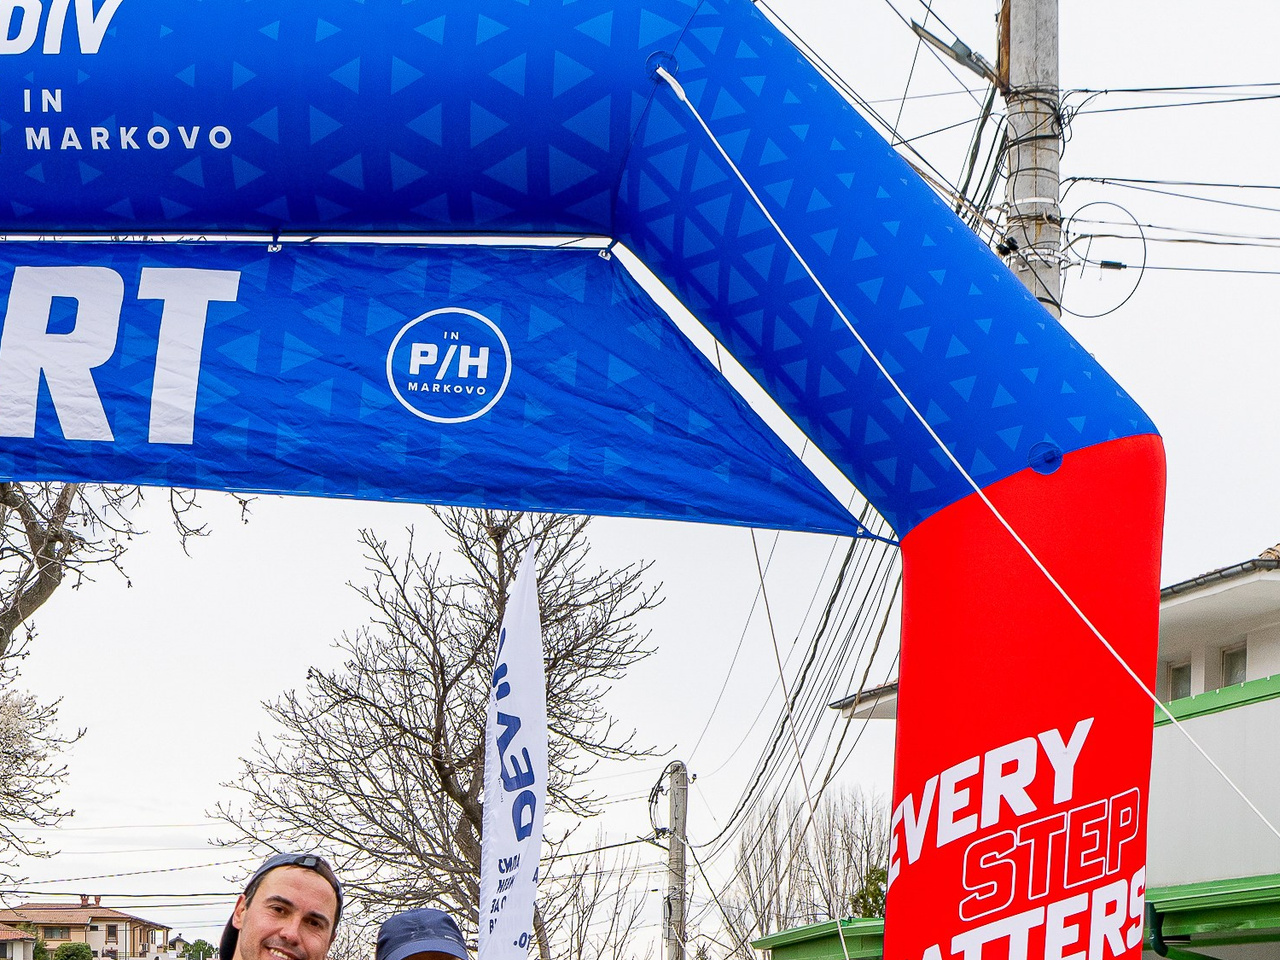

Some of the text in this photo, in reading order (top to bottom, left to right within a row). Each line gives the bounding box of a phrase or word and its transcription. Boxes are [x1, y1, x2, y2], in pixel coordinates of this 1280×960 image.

[24, 89, 62, 112] IN
[25, 126, 234, 149] MARKOVO
[443, 331, 459, 340] IN
[409, 342, 489, 380] P/H
[408, 382, 486, 396] MARKOVO
[887, 717, 1095, 889] EVERY
[959, 786, 1140, 922] STEP
